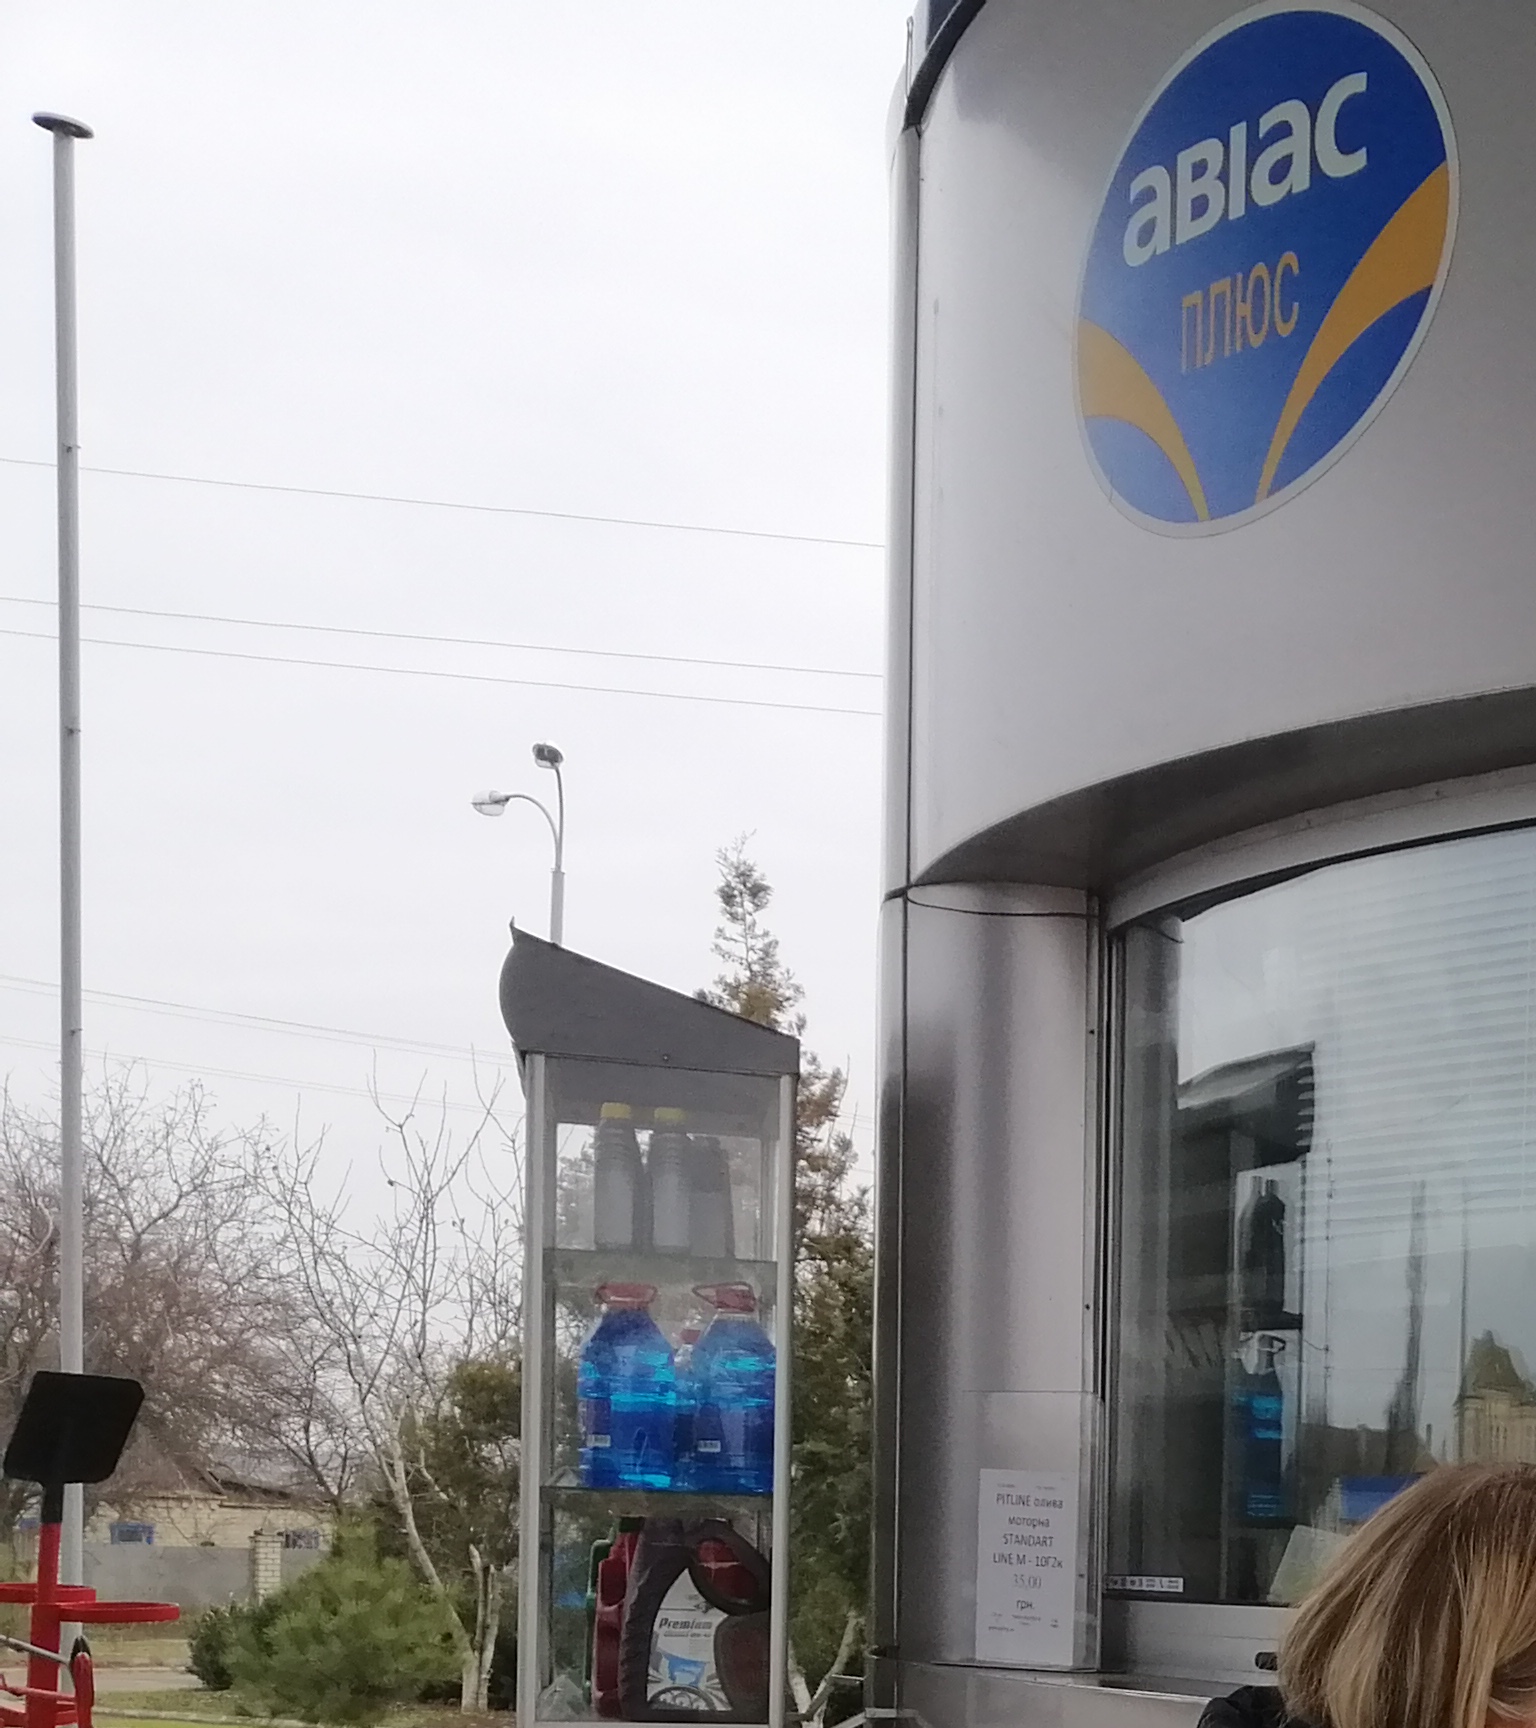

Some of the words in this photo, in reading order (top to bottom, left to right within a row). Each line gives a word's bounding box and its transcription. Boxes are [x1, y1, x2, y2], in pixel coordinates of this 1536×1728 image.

[1181, 251, 1300, 375] ПЛЮС
[996, 1493, 1031, 1507] PITLINE
[1033, 1498, 1064, 1509] олива
[1008, 1516, 1050, 1529] моторна
[1003, 1533, 1054, 1547] STANDART
[658, 1617, 713, 1630] Premium
